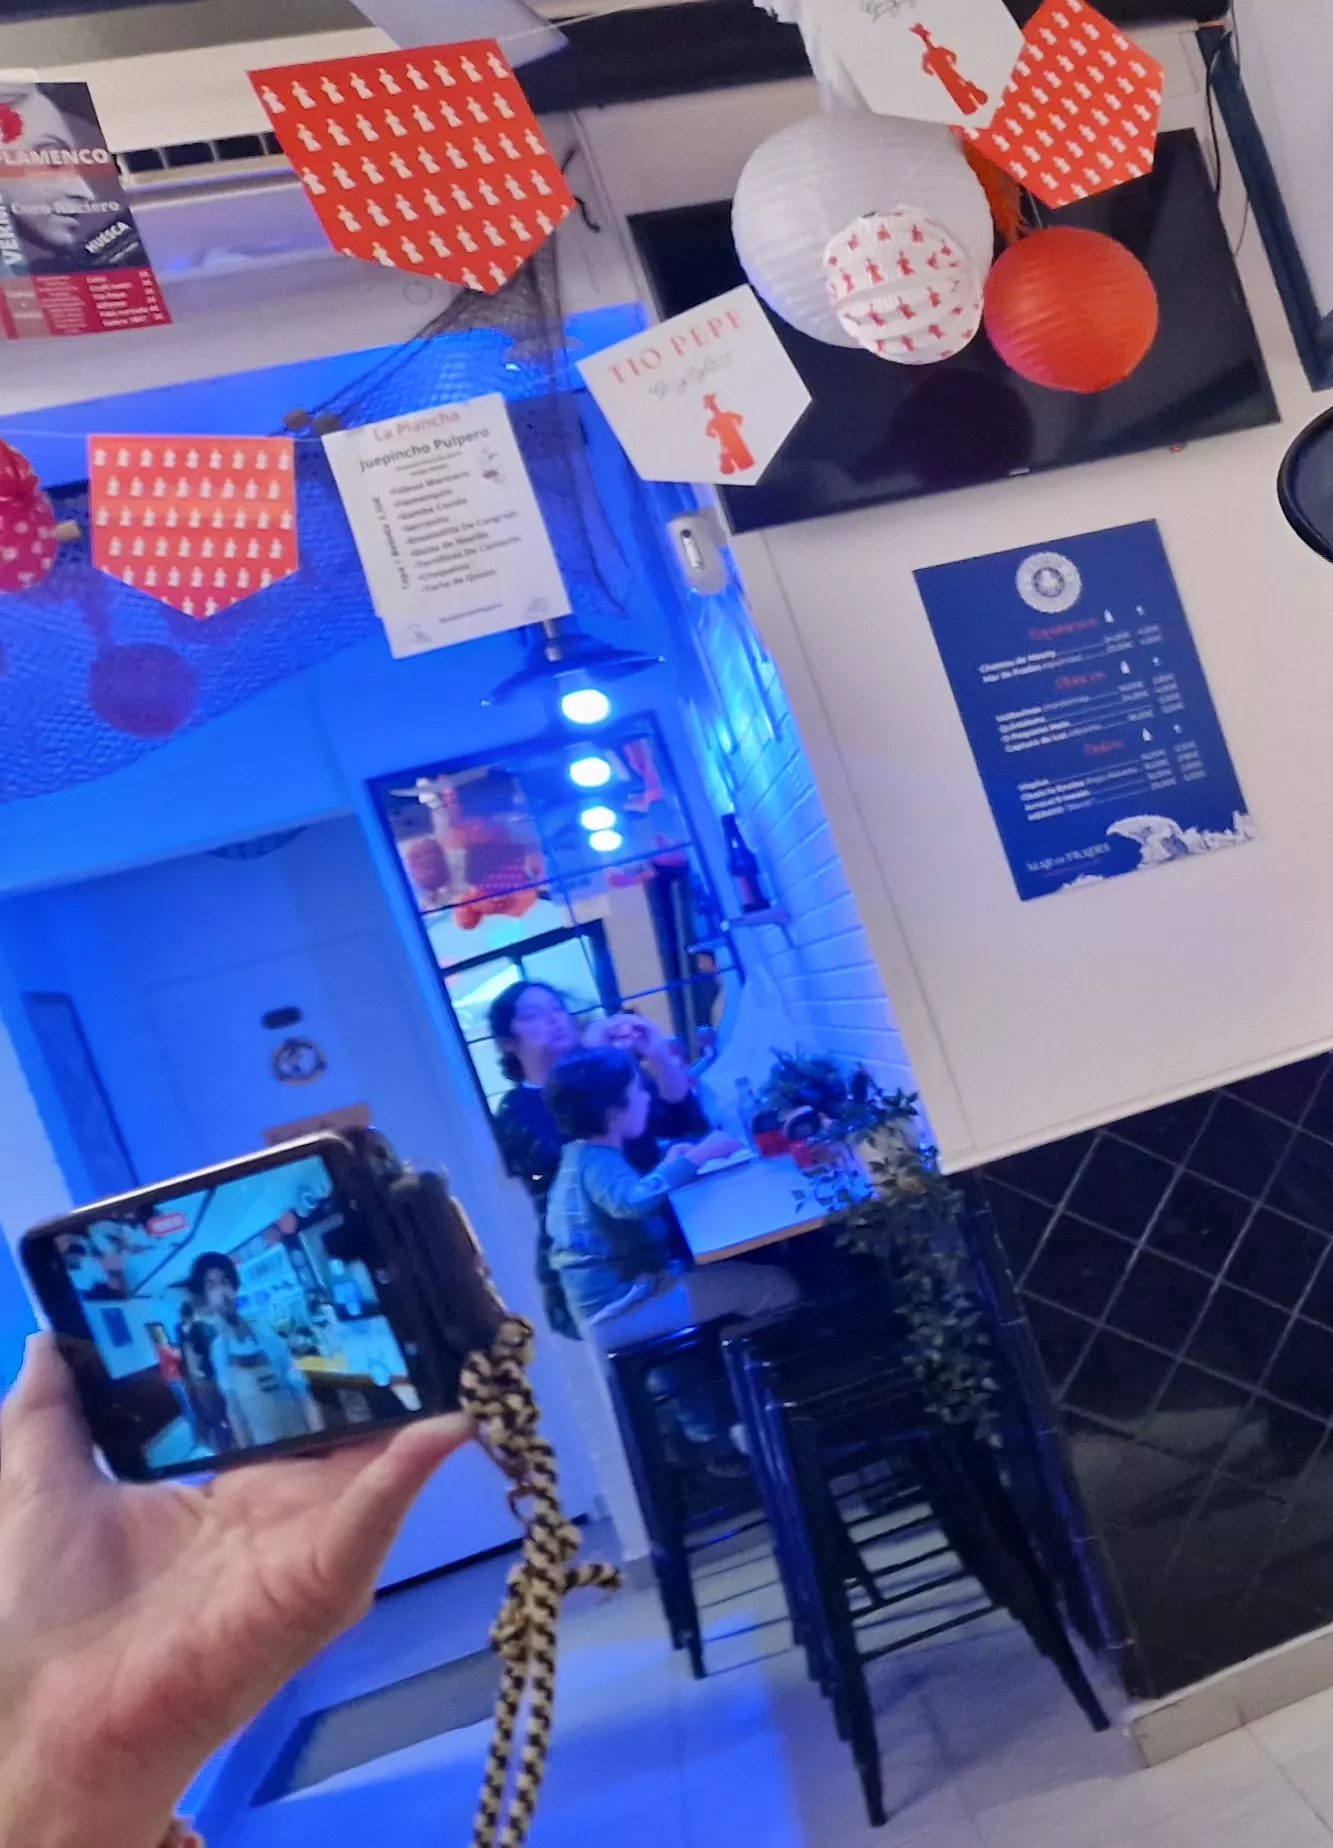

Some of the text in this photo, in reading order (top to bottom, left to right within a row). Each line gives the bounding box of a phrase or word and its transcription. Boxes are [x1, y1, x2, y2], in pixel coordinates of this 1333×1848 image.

[0, 147, 109, 165] LAMENCO
[607, 348, 662, 385] TIO
[669, 309, 743, 356] PEPE
[372, 410, 460, 443] La Plancha
[359, 443, 431, 473] Juepincho
[433, 427, 490, 451] Pulpero
